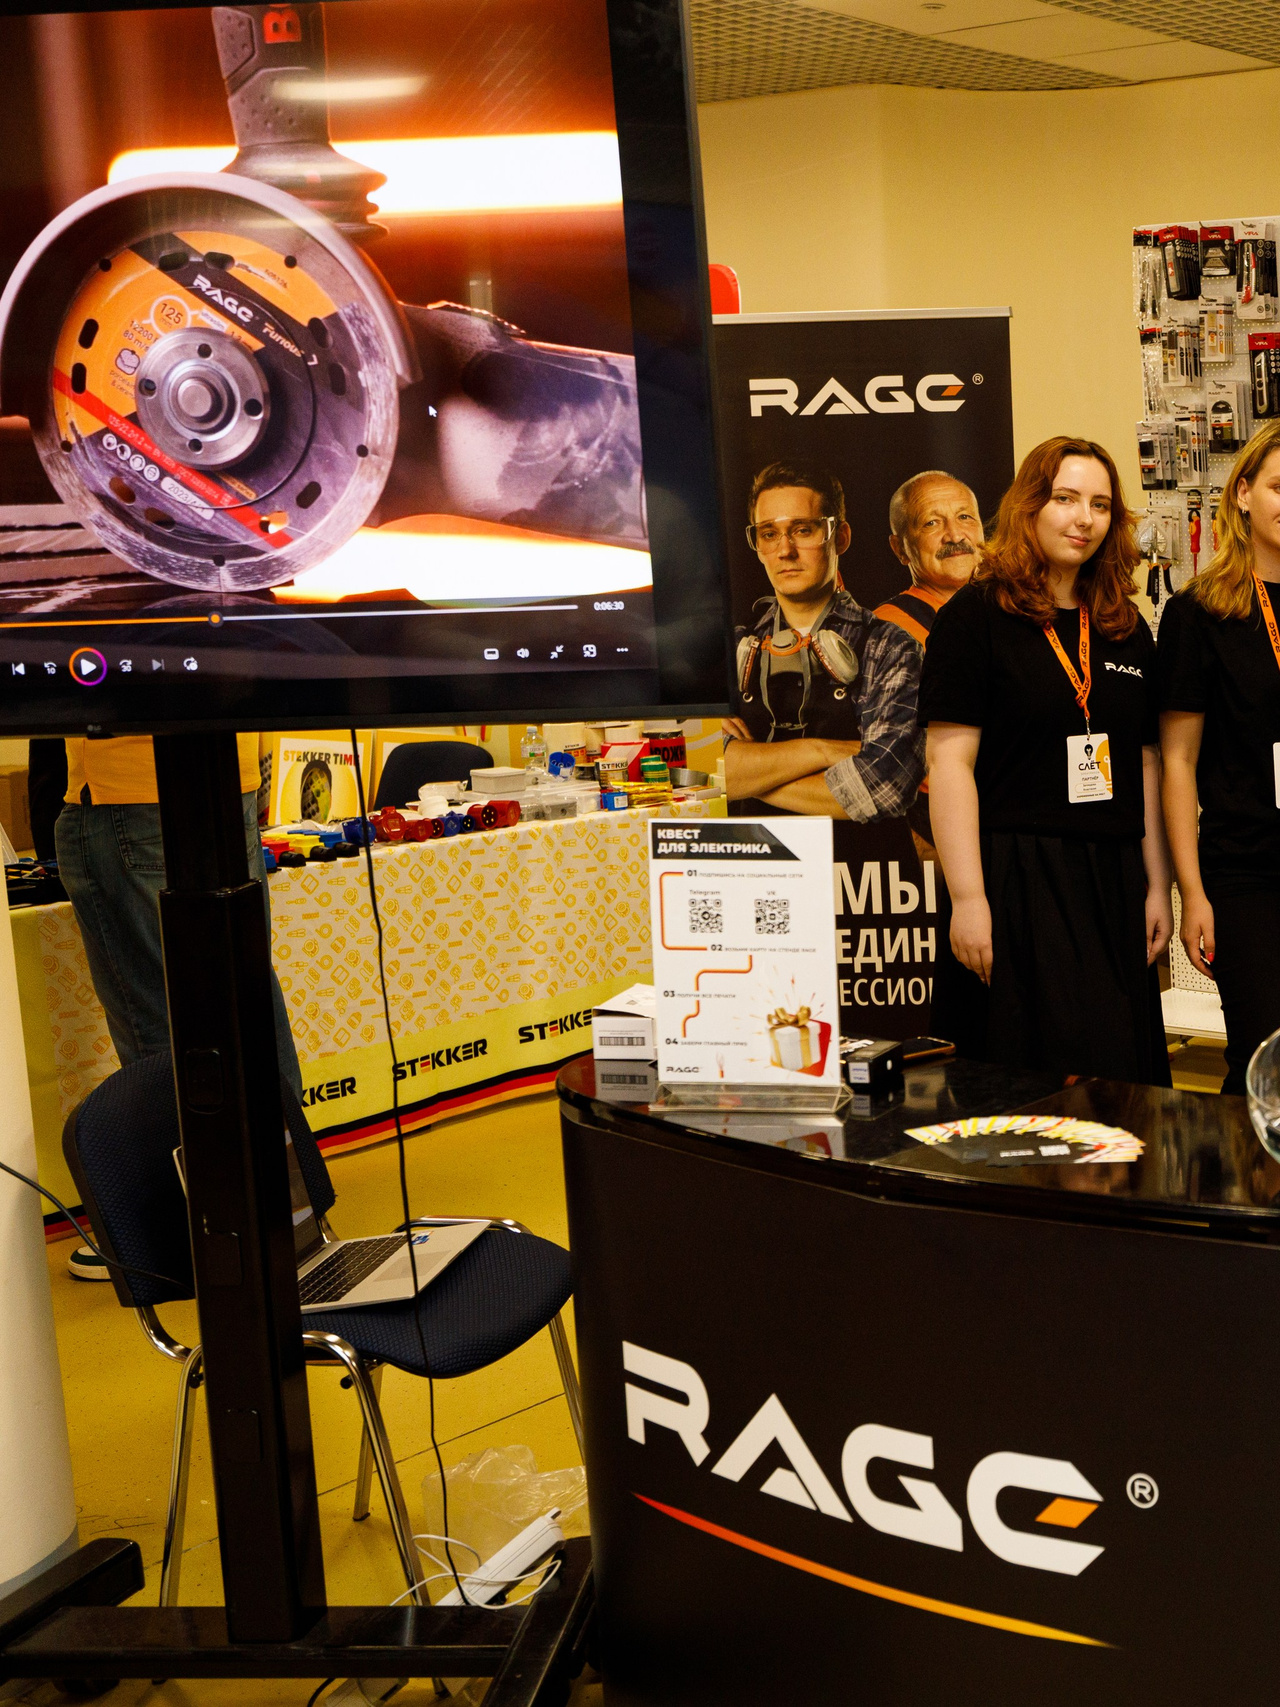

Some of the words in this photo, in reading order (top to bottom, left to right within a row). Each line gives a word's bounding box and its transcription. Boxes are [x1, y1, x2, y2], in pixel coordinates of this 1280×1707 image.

[161, 303, 183, 324] 125
[123, 329, 134, 341] 80
[130, 321, 153, 340] 12200
[262, 322, 304, 357] Furious
[749, 373, 965, 417] RAGE
[594, 601, 625, 611] 0:06:30
[283, 750, 331, 764] STEKKER
[657, 828, 701, 840] КВЕСТ
[657, 843, 687, 855] ДЛЯ
[690, 842, 772, 855] ЭЛЕКТРИКА
[833, 860, 937, 915] МЫ
[835, 927, 936, 973] ЕДИН
[663, 990, 675, 998] 03
[392, 1038, 488, 1082] STEKKER
[622, 1340, 1106, 1577] RAGE
